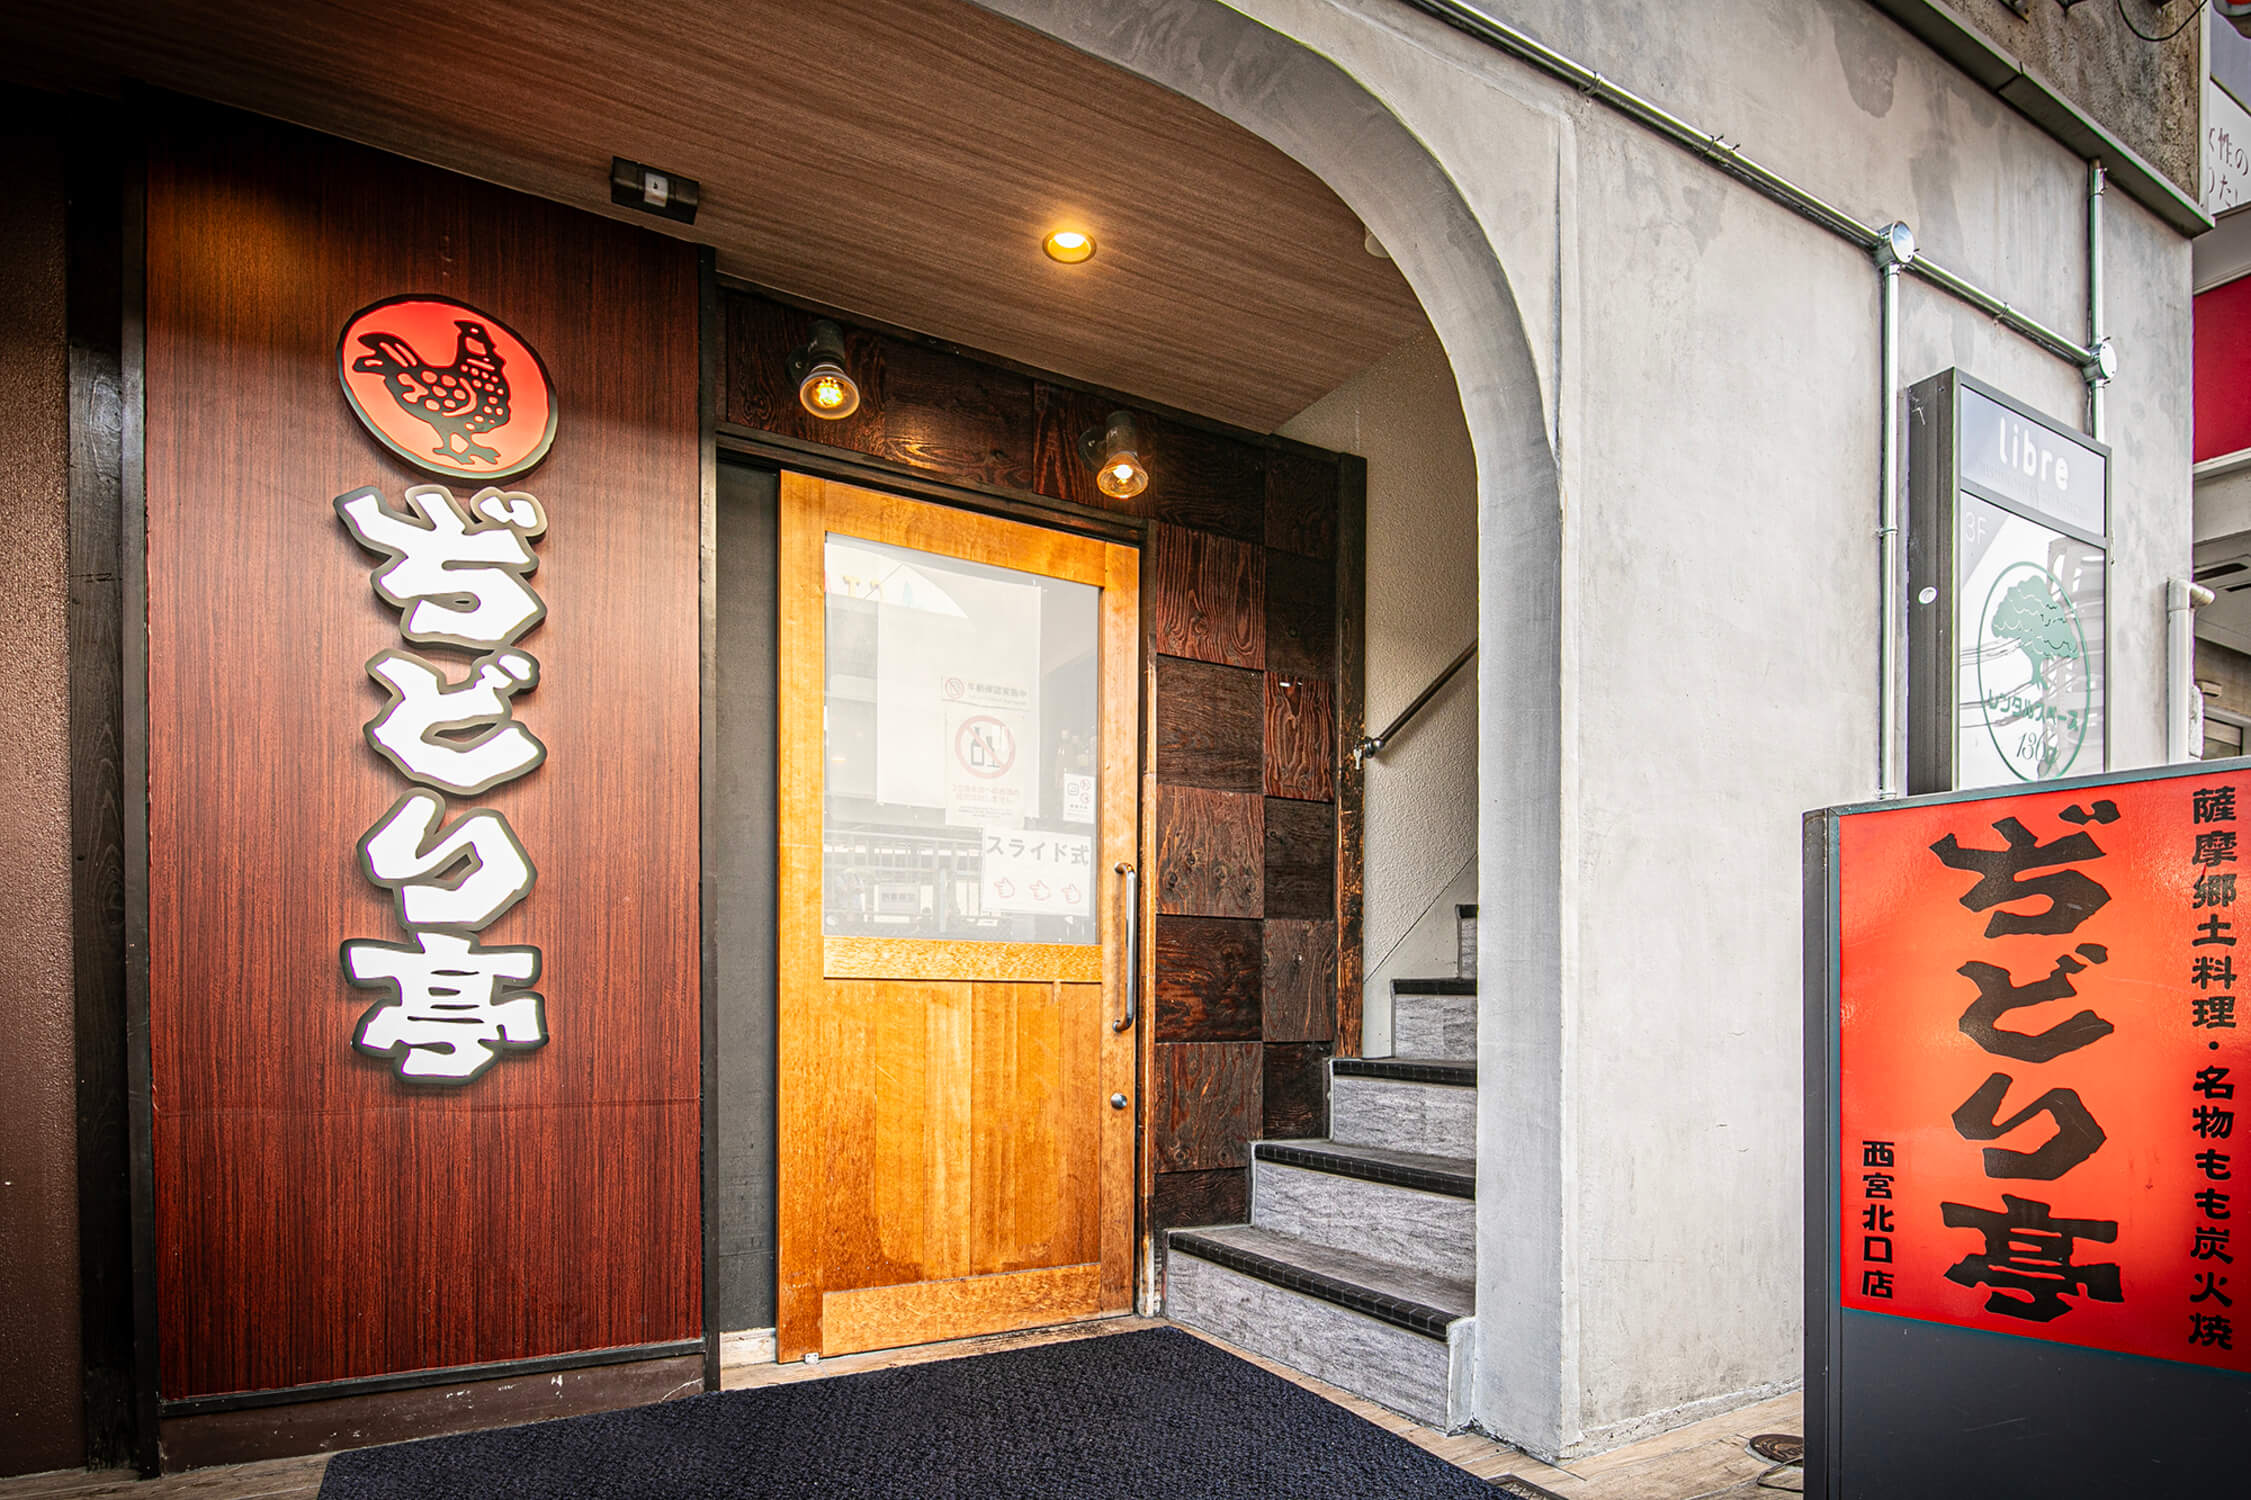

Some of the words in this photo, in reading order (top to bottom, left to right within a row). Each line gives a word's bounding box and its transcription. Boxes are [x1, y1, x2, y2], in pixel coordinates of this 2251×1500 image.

[1998, 417, 2070, 492] libre
[338, 488, 549, 1082] ぢどり亭
[985, 835, 1090, 867] スライド式
[1929, 799, 2125, 1323] ぢどり亭
[1861, 1139, 1895, 1300] 西宮北口店
